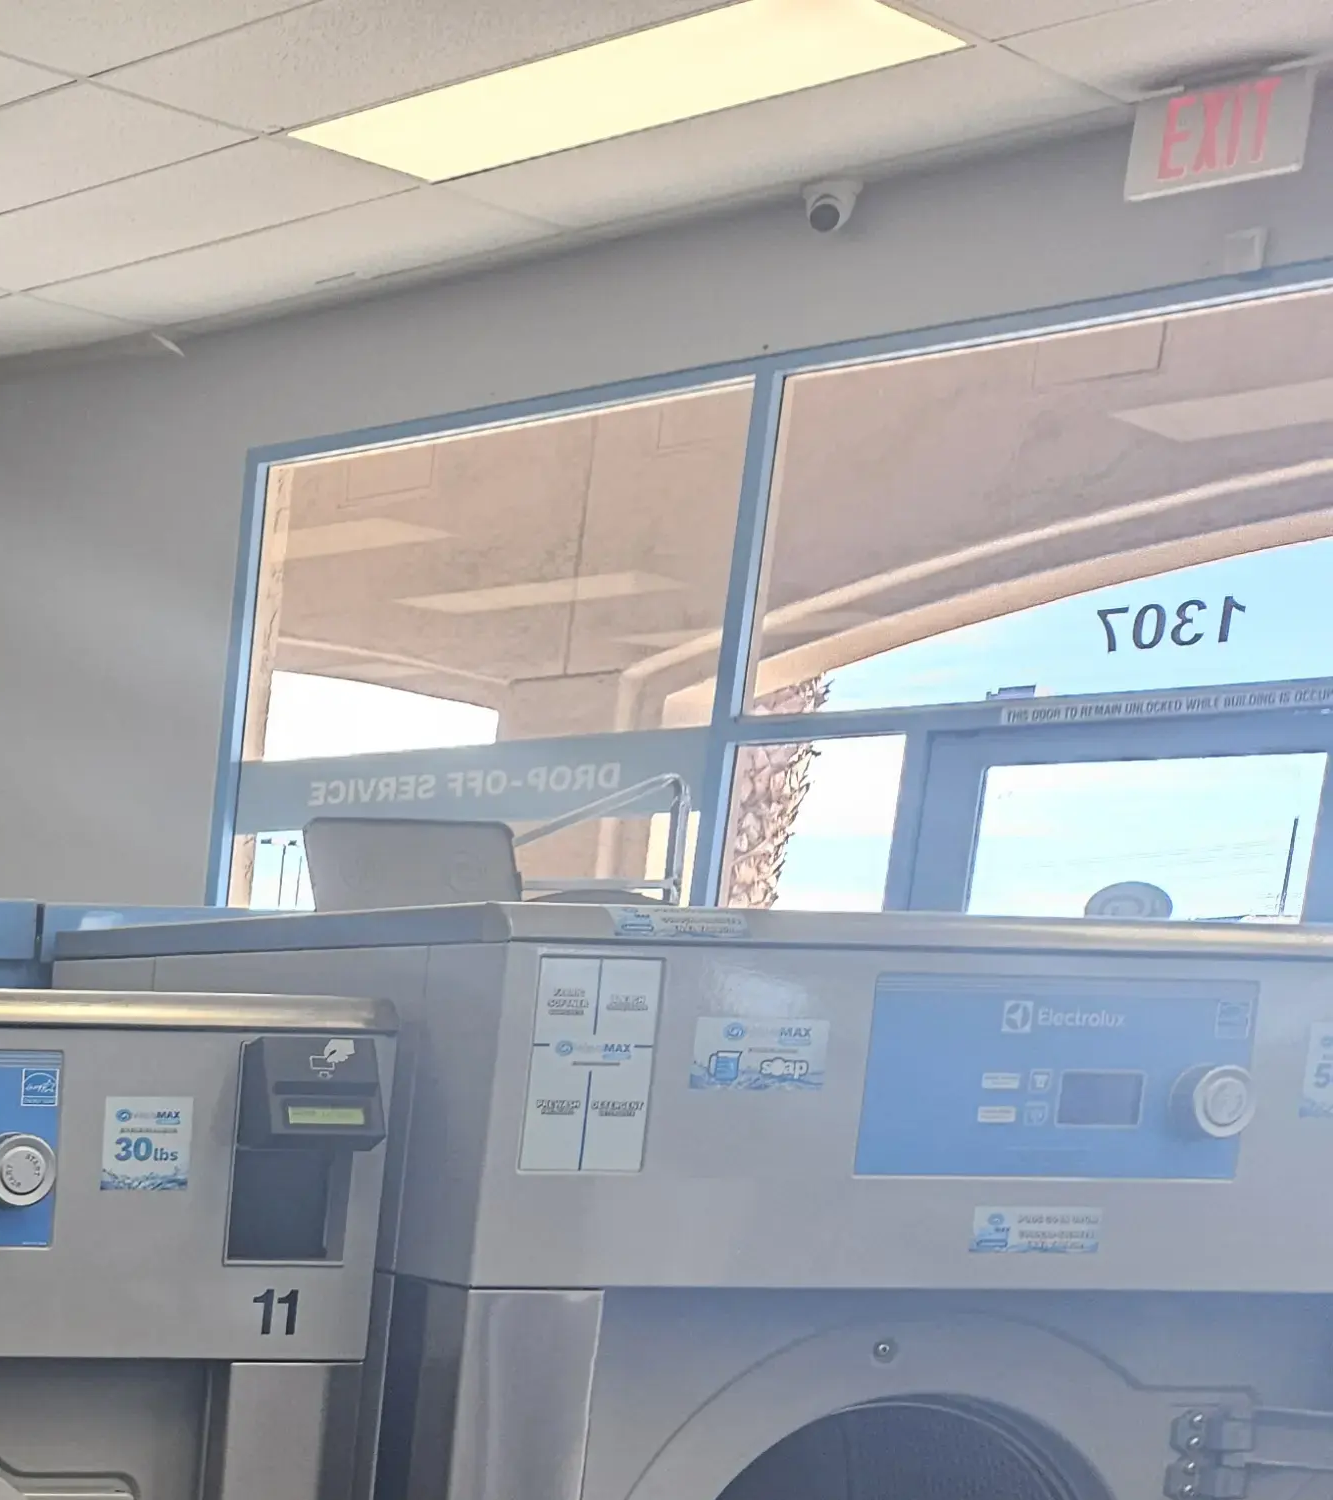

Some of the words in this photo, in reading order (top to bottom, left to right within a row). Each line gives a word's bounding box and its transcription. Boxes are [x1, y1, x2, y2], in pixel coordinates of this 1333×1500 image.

[1157, 76, 1282, 182] EXIT
[1007, 708, 1028, 723] THIS
[1064, 708, 1078, 720] TO
[1125, 699, 1182, 715] UNLOCKED
[1186, 695, 1219, 711] WHILE
[1037, 1006, 1126, 1028] Electrolux
[114, 1136, 179, 1162] 30lbs
[25, 1153, 41, 1177] START
[252, 1288, 300, 1335] 11
